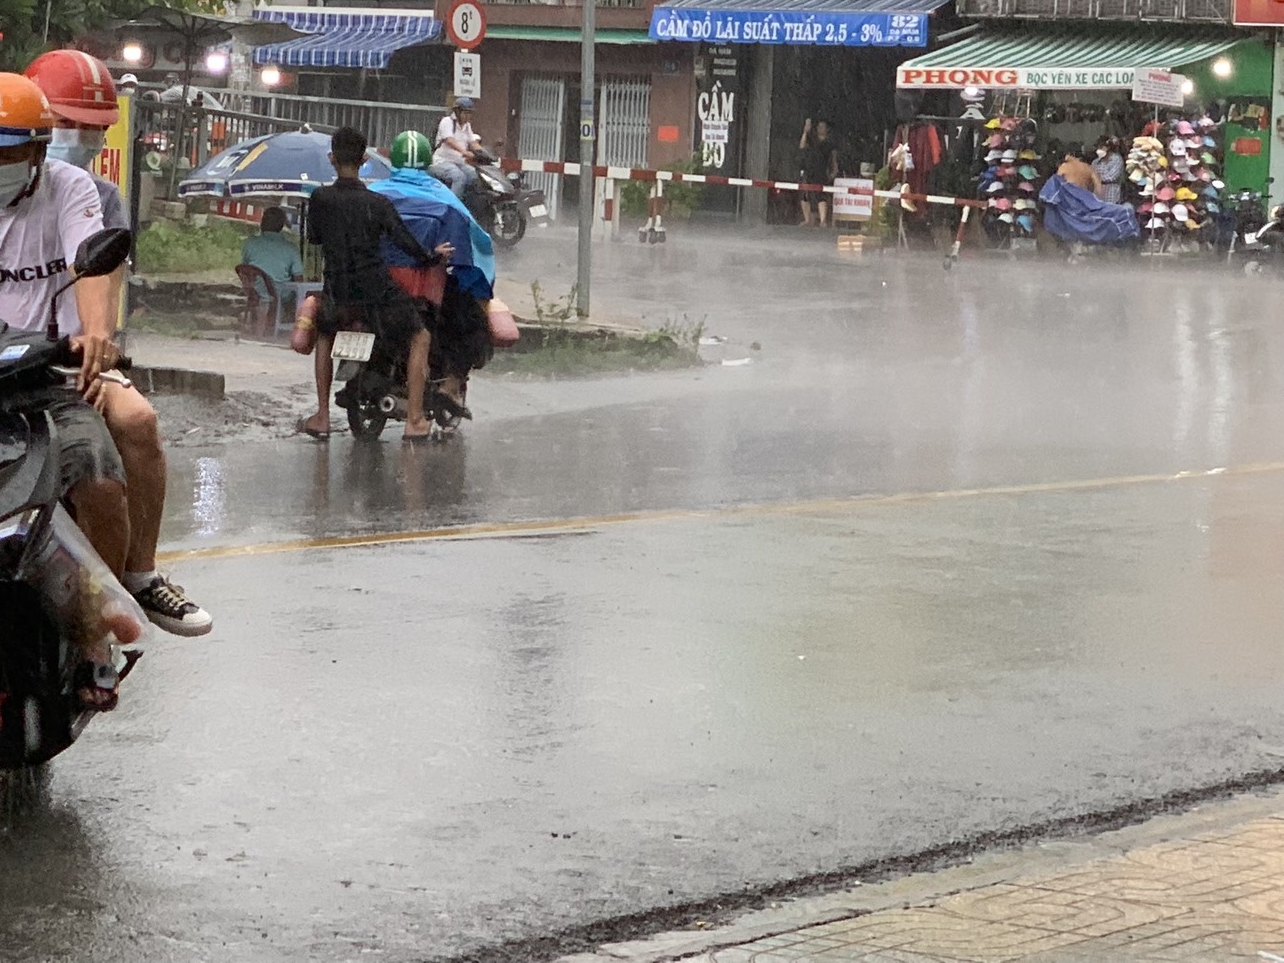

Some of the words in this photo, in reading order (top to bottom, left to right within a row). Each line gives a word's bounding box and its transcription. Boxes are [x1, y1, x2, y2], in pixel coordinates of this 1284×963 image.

[656, 9, 689, 38] CẦM
[691, 9, 712, 38] ĐỒ
[715, 16, 740, 39] LÃI
[742, 13, 781, 40] SUẤT
[783, 14, 822, 42] THẤP
[824, 23, 848, 44] 2,5
[860, 23, 883, 43] 3%
[890, 15, 920, 28] 82
[1026, 72, 1048, 87] BỌC
[1051, 69, 1072, 84] YÊN
[1074, 72, 1089, 85] XE
[697, 79, 735, 123] CẦM
